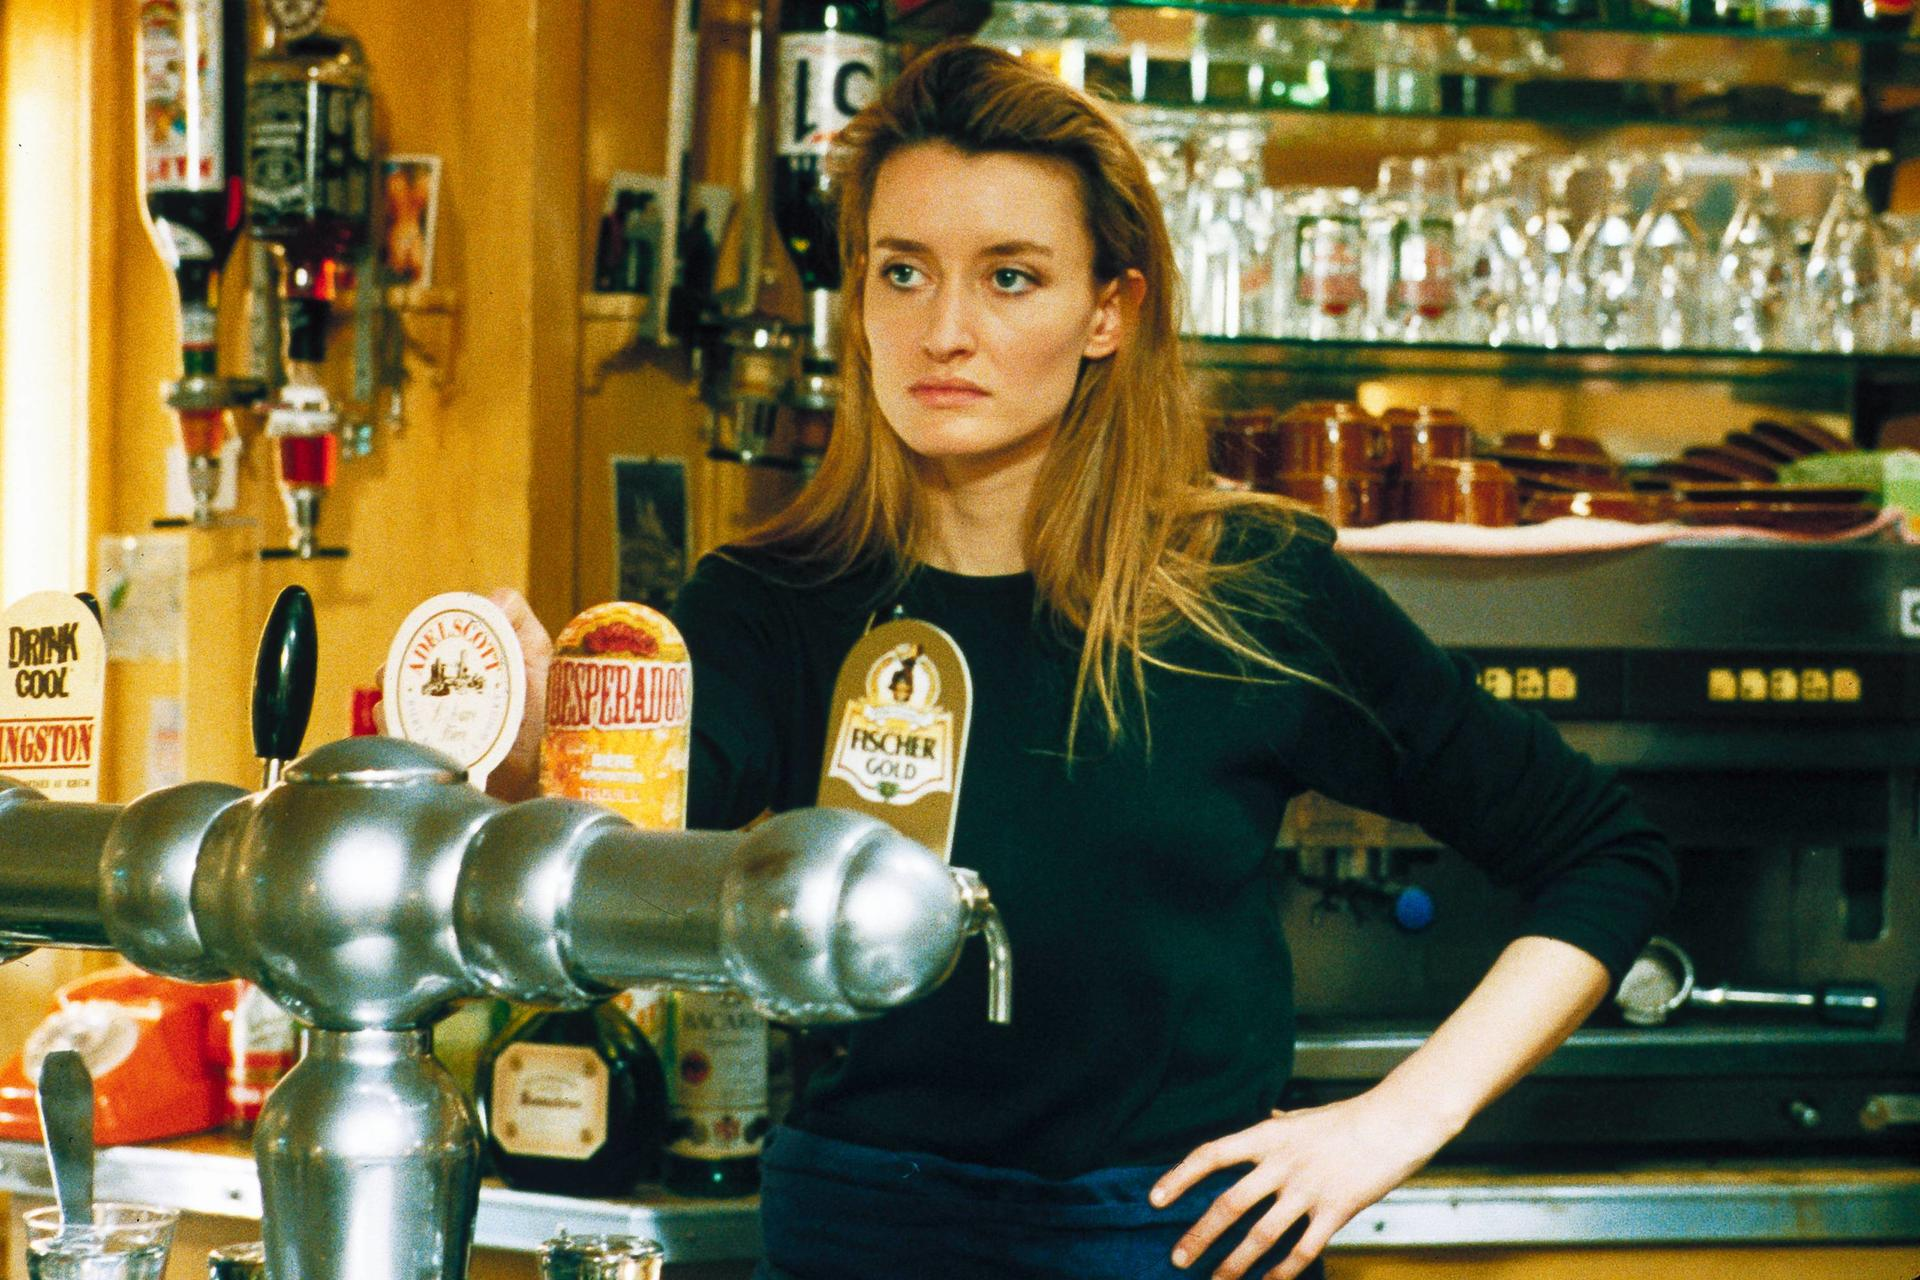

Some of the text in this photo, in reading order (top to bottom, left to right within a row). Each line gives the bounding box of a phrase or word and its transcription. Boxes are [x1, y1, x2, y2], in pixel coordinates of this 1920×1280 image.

[8, 622, 79, 669] DRINK
[15, 667, 69, 698] COOL
[546, 660, 687, 726] DESPERADOS
[851, 728, 936, 760] FISCHER
[866, 758, 917, 779] GOLD
